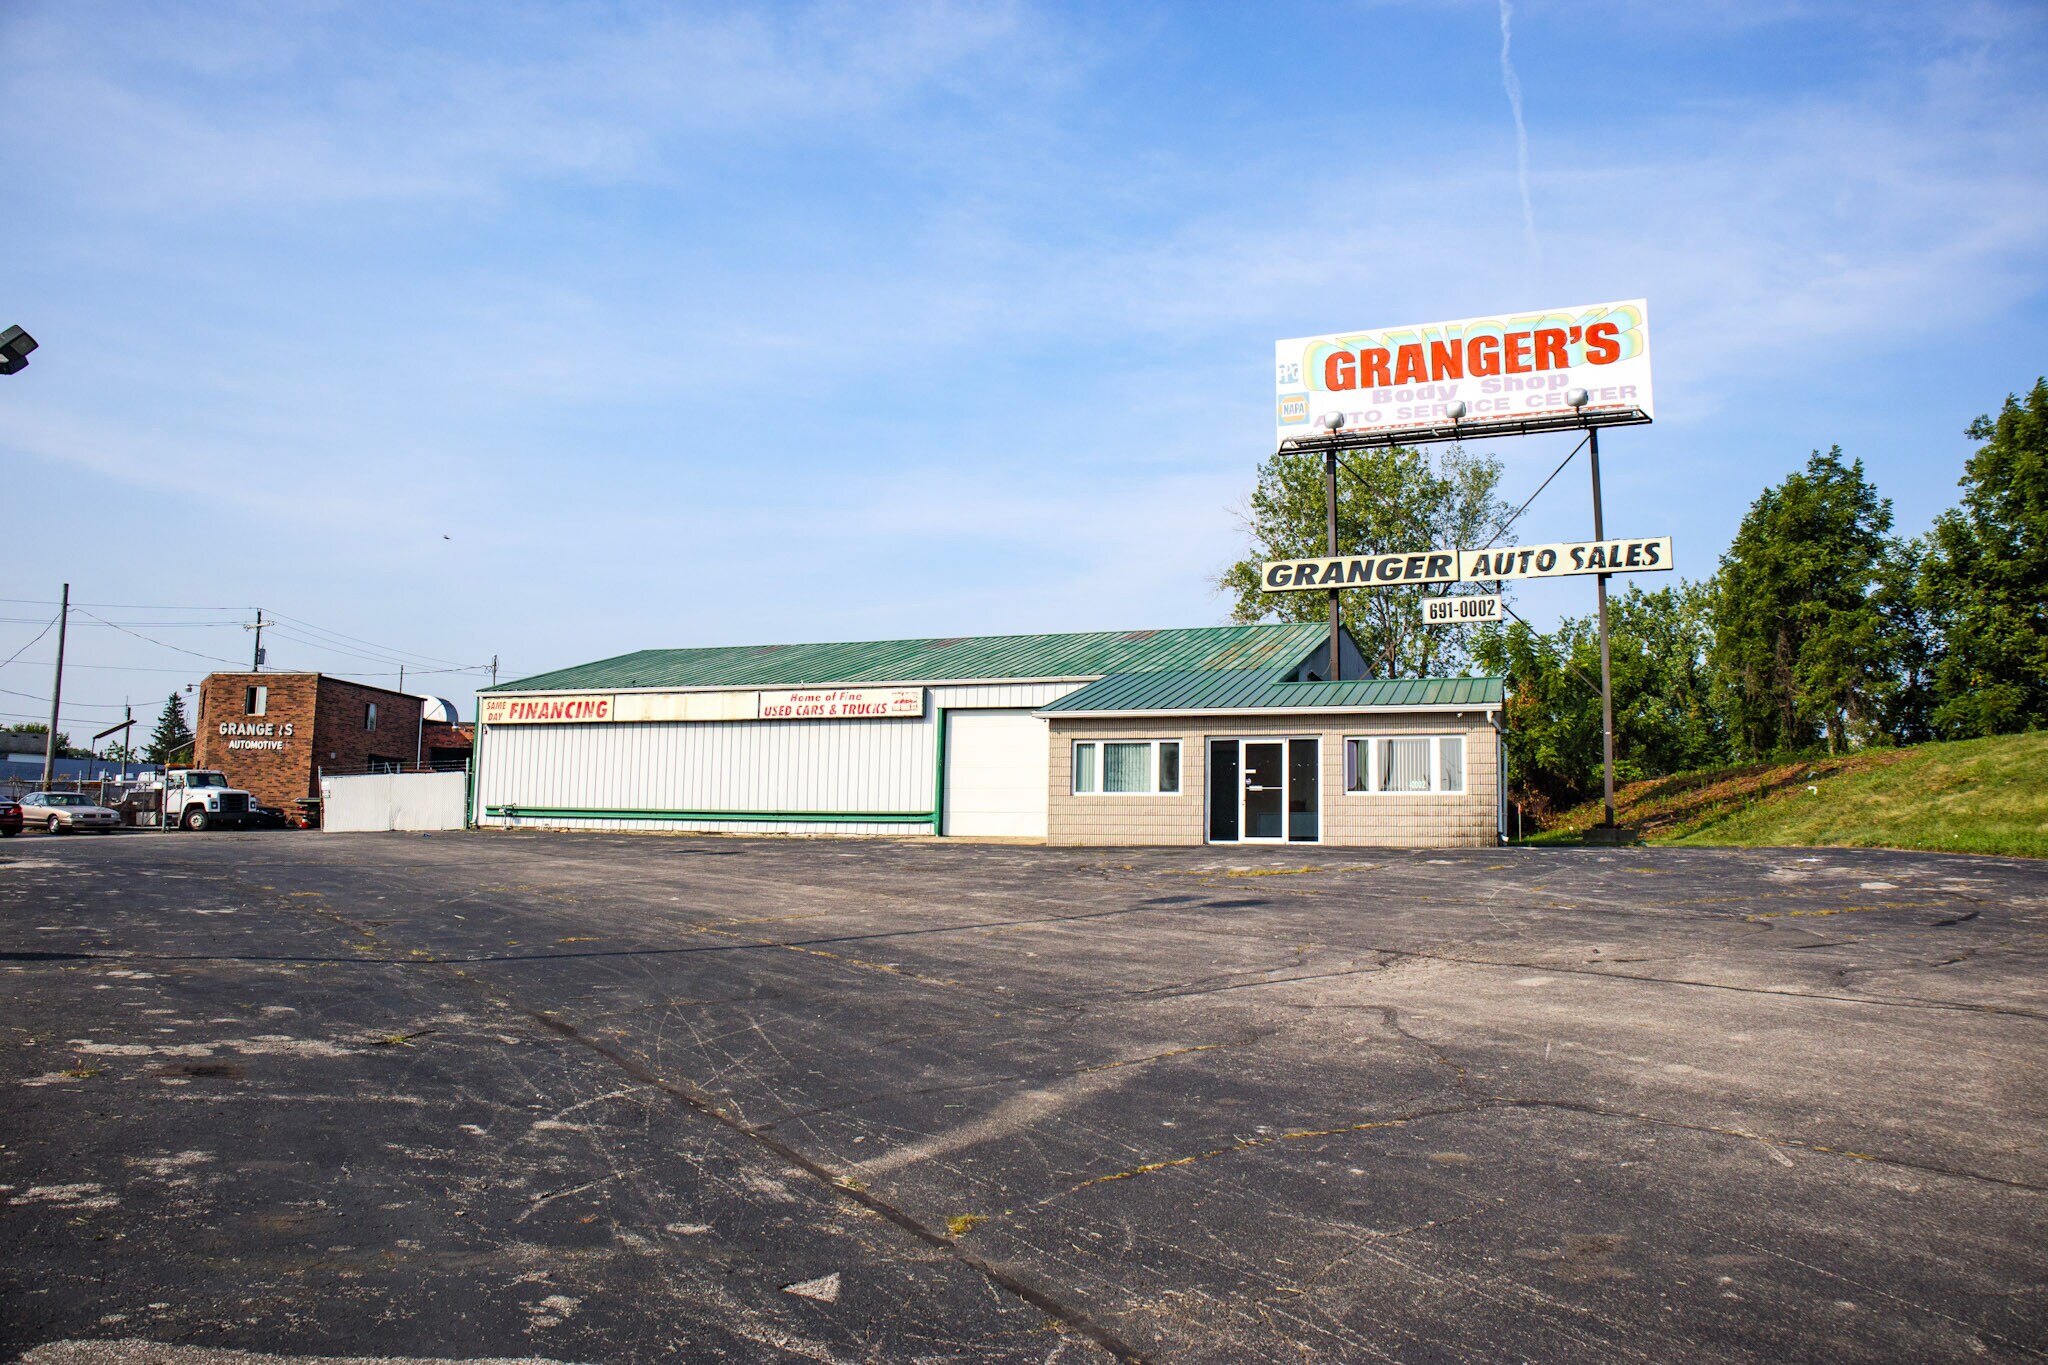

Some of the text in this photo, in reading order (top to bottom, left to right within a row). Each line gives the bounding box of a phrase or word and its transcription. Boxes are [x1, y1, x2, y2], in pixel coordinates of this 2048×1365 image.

[1325, 322, 1620, 391] GRANGER'S
[1372, 373, 1569, 404] Body Shop
[1283, 403, 1304, 415] NAPA
[1313, 409, 1382, 428] ATO
[1396, 397, 1511, 420] SERICE
[1525, 385, 1637, 408] CETER
[1267, 542, 1661, 587] GRANGER AUTO SALES
[1429, 599, 1496, 620] 691-0002
[790, 691, 862, 702] Home of Fine
[486, 700, 608, 720] SAME FINANCING
[487, 712, 503, 721] DAY
[764, 703, 887, 716] USED CARS & TRUCKS
[229, 740, 283, 750] AUTOMOTIVE
